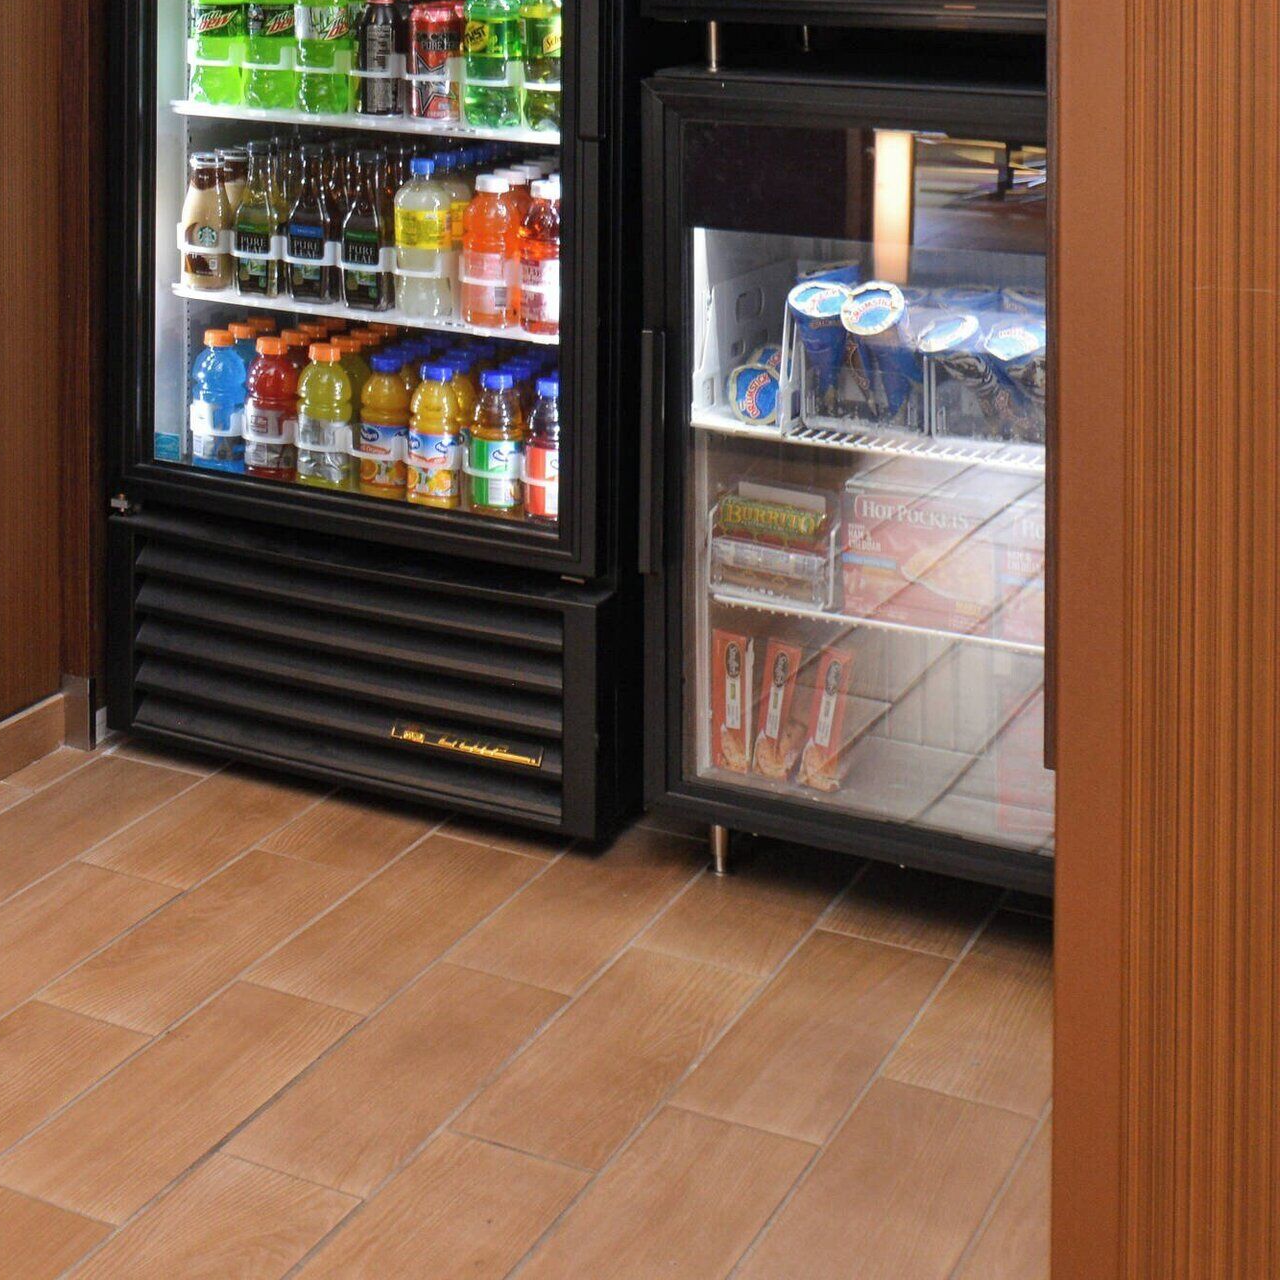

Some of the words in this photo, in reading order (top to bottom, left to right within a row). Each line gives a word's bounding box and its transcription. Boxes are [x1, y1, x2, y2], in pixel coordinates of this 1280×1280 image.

[240, 235, 267, 247] PURE
[293, 240, 320, 252] PURE
[348, 244, 376, 257] PURE
